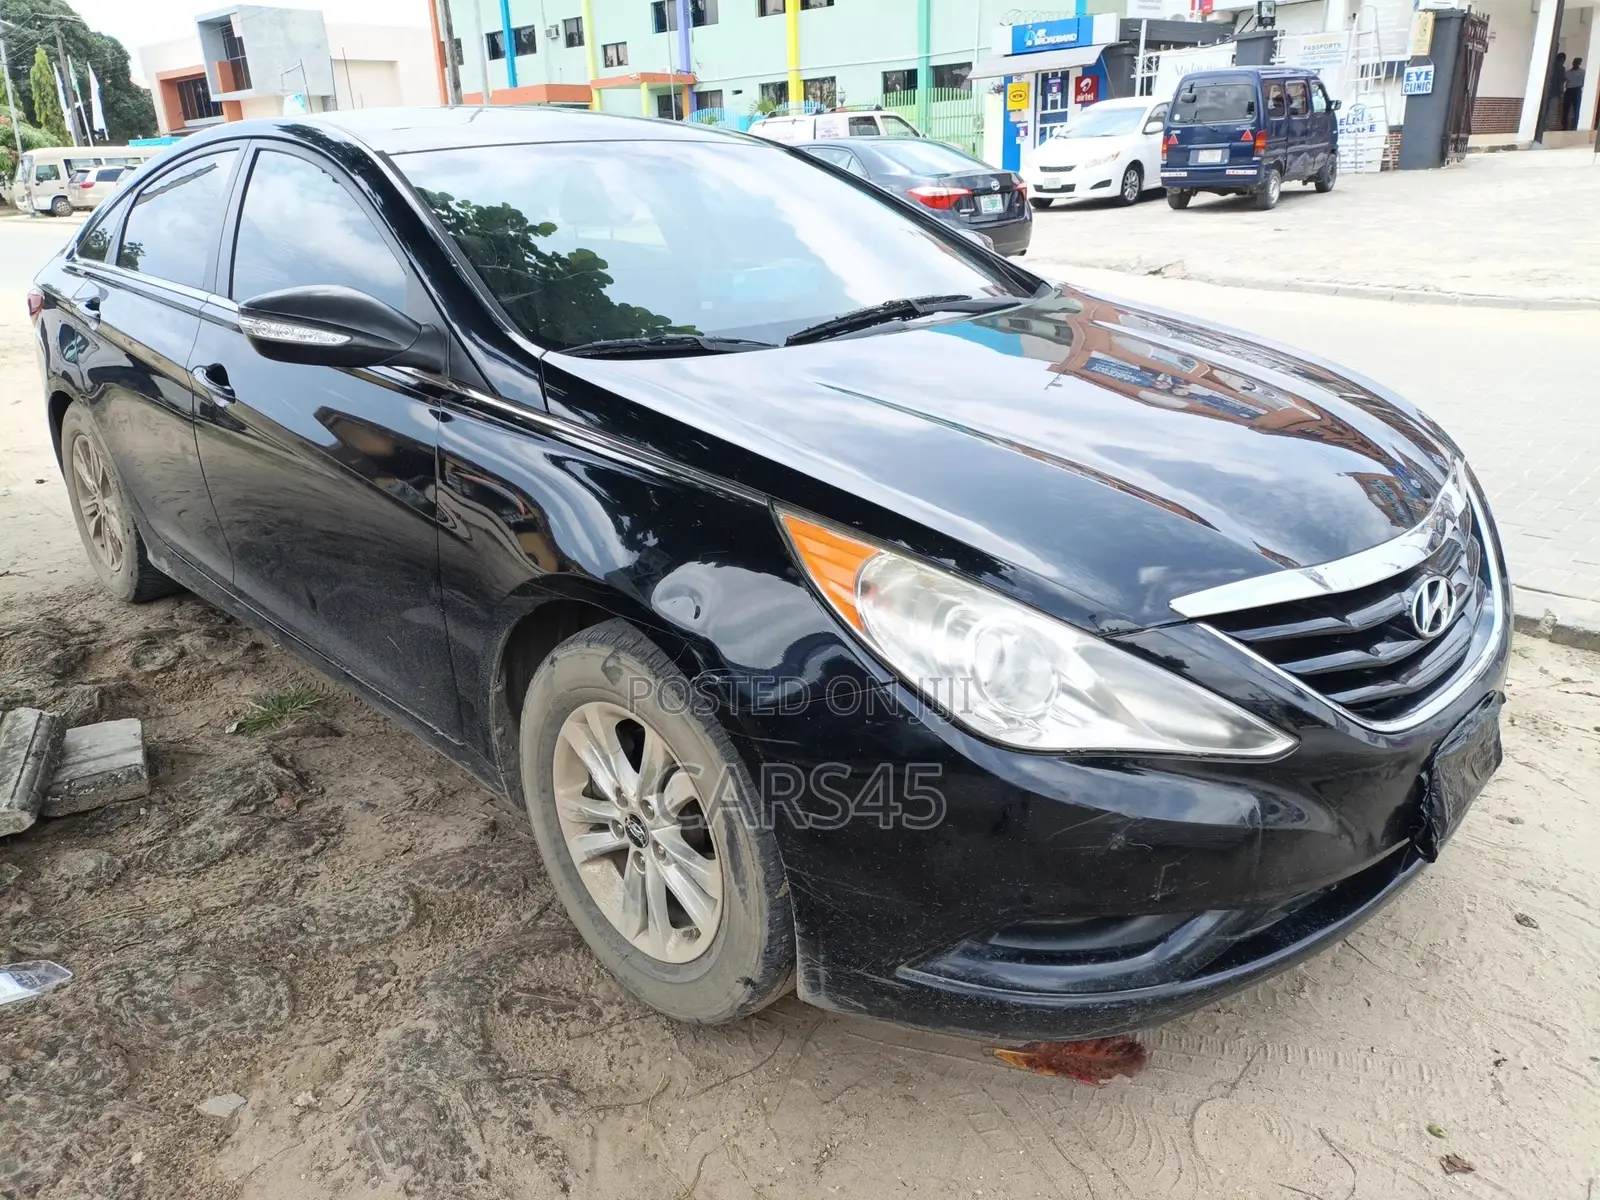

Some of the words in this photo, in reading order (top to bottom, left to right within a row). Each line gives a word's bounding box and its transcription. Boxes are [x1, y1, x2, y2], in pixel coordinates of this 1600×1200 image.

[1303, 42, 1342, 51] PASSPORTS
[1405, 70, 1432, 82] EYE
[1403, 81, 1431, 93] CLINIC
[1076, 92, 1094, 102] airtel
